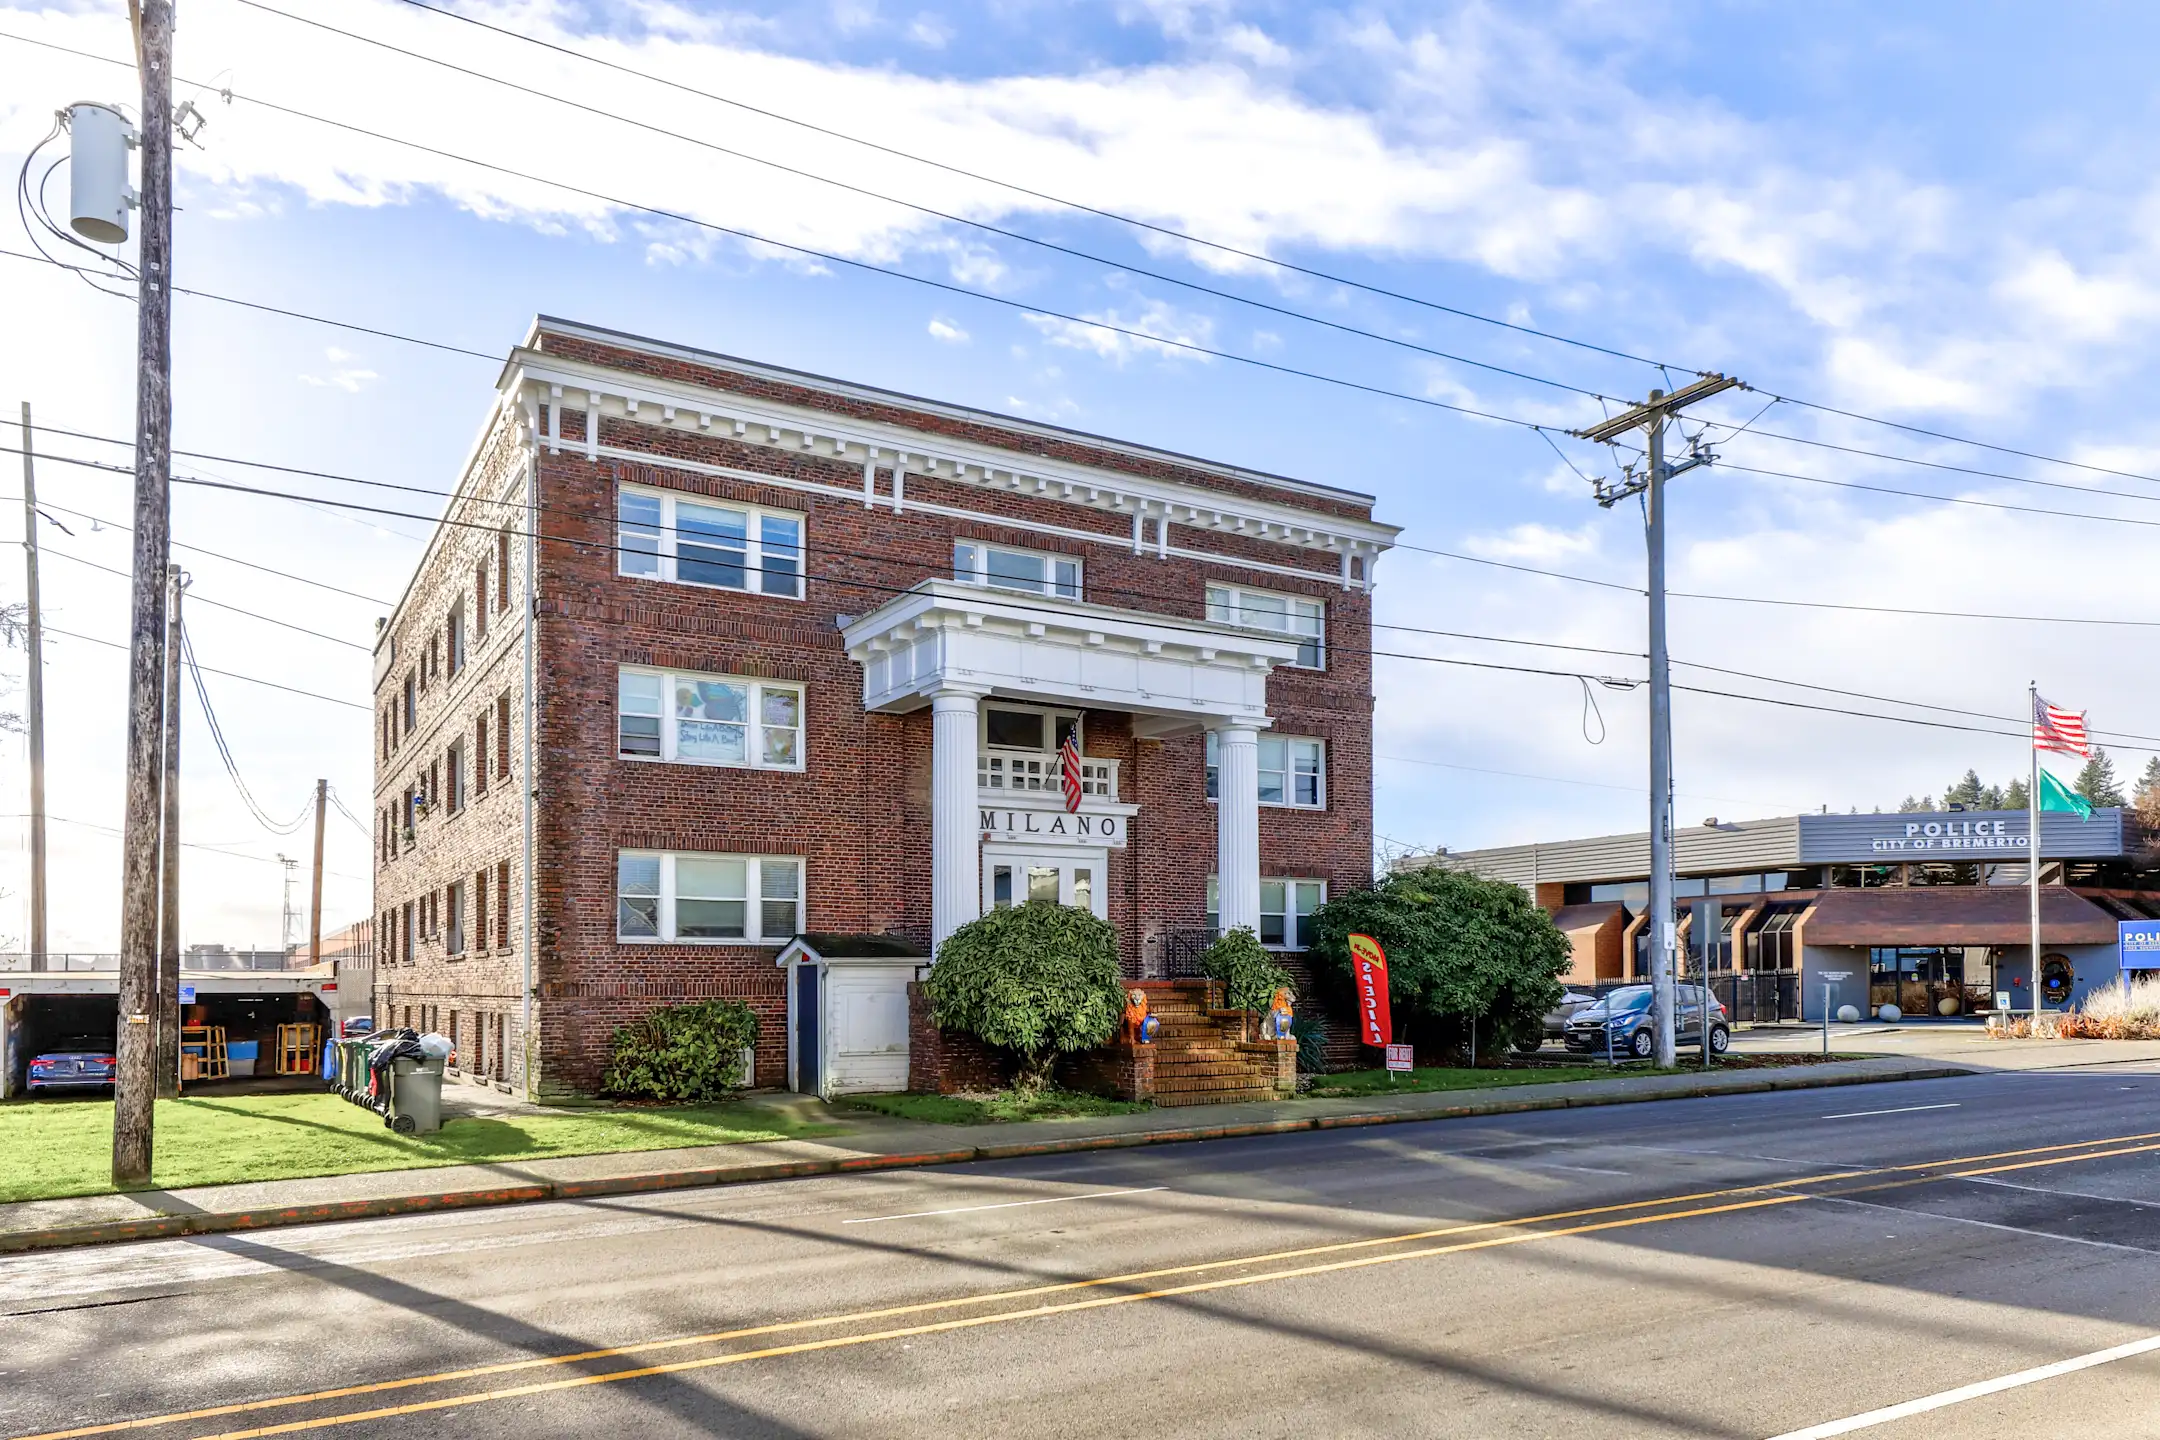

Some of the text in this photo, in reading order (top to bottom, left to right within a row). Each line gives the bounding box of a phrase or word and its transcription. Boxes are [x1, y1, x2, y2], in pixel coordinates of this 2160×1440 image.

[979, 810, 1115, 836] MILANO
[1905, 820, 2005, 838] POLICE
[1872, 836, 2041, 850] CITY OF BREMERTO
[1388, 1047, 1411, 1061] FOR RENT
